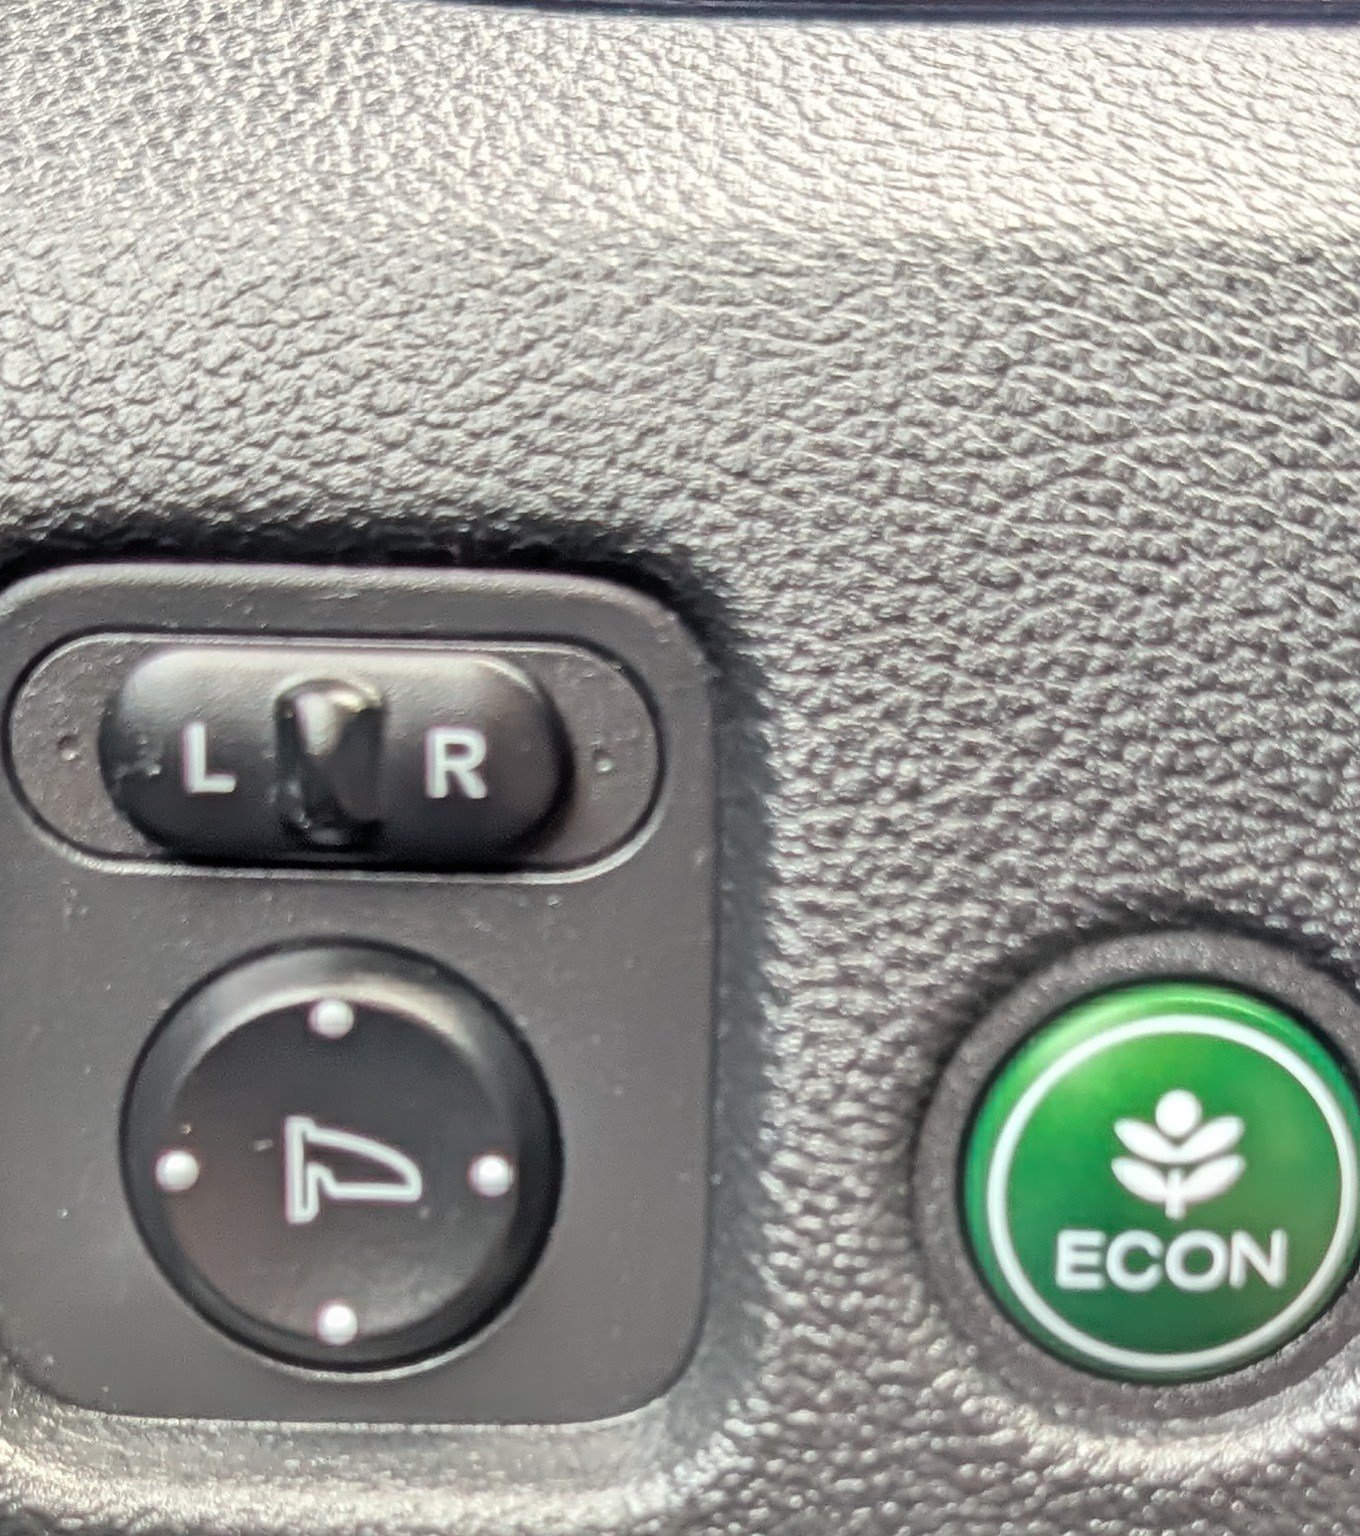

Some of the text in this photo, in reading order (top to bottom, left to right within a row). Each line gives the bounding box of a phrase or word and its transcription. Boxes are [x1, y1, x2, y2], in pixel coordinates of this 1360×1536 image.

[182, 722, 488, 799] L R
[1055, 1228, 1288, 1292] ECON
